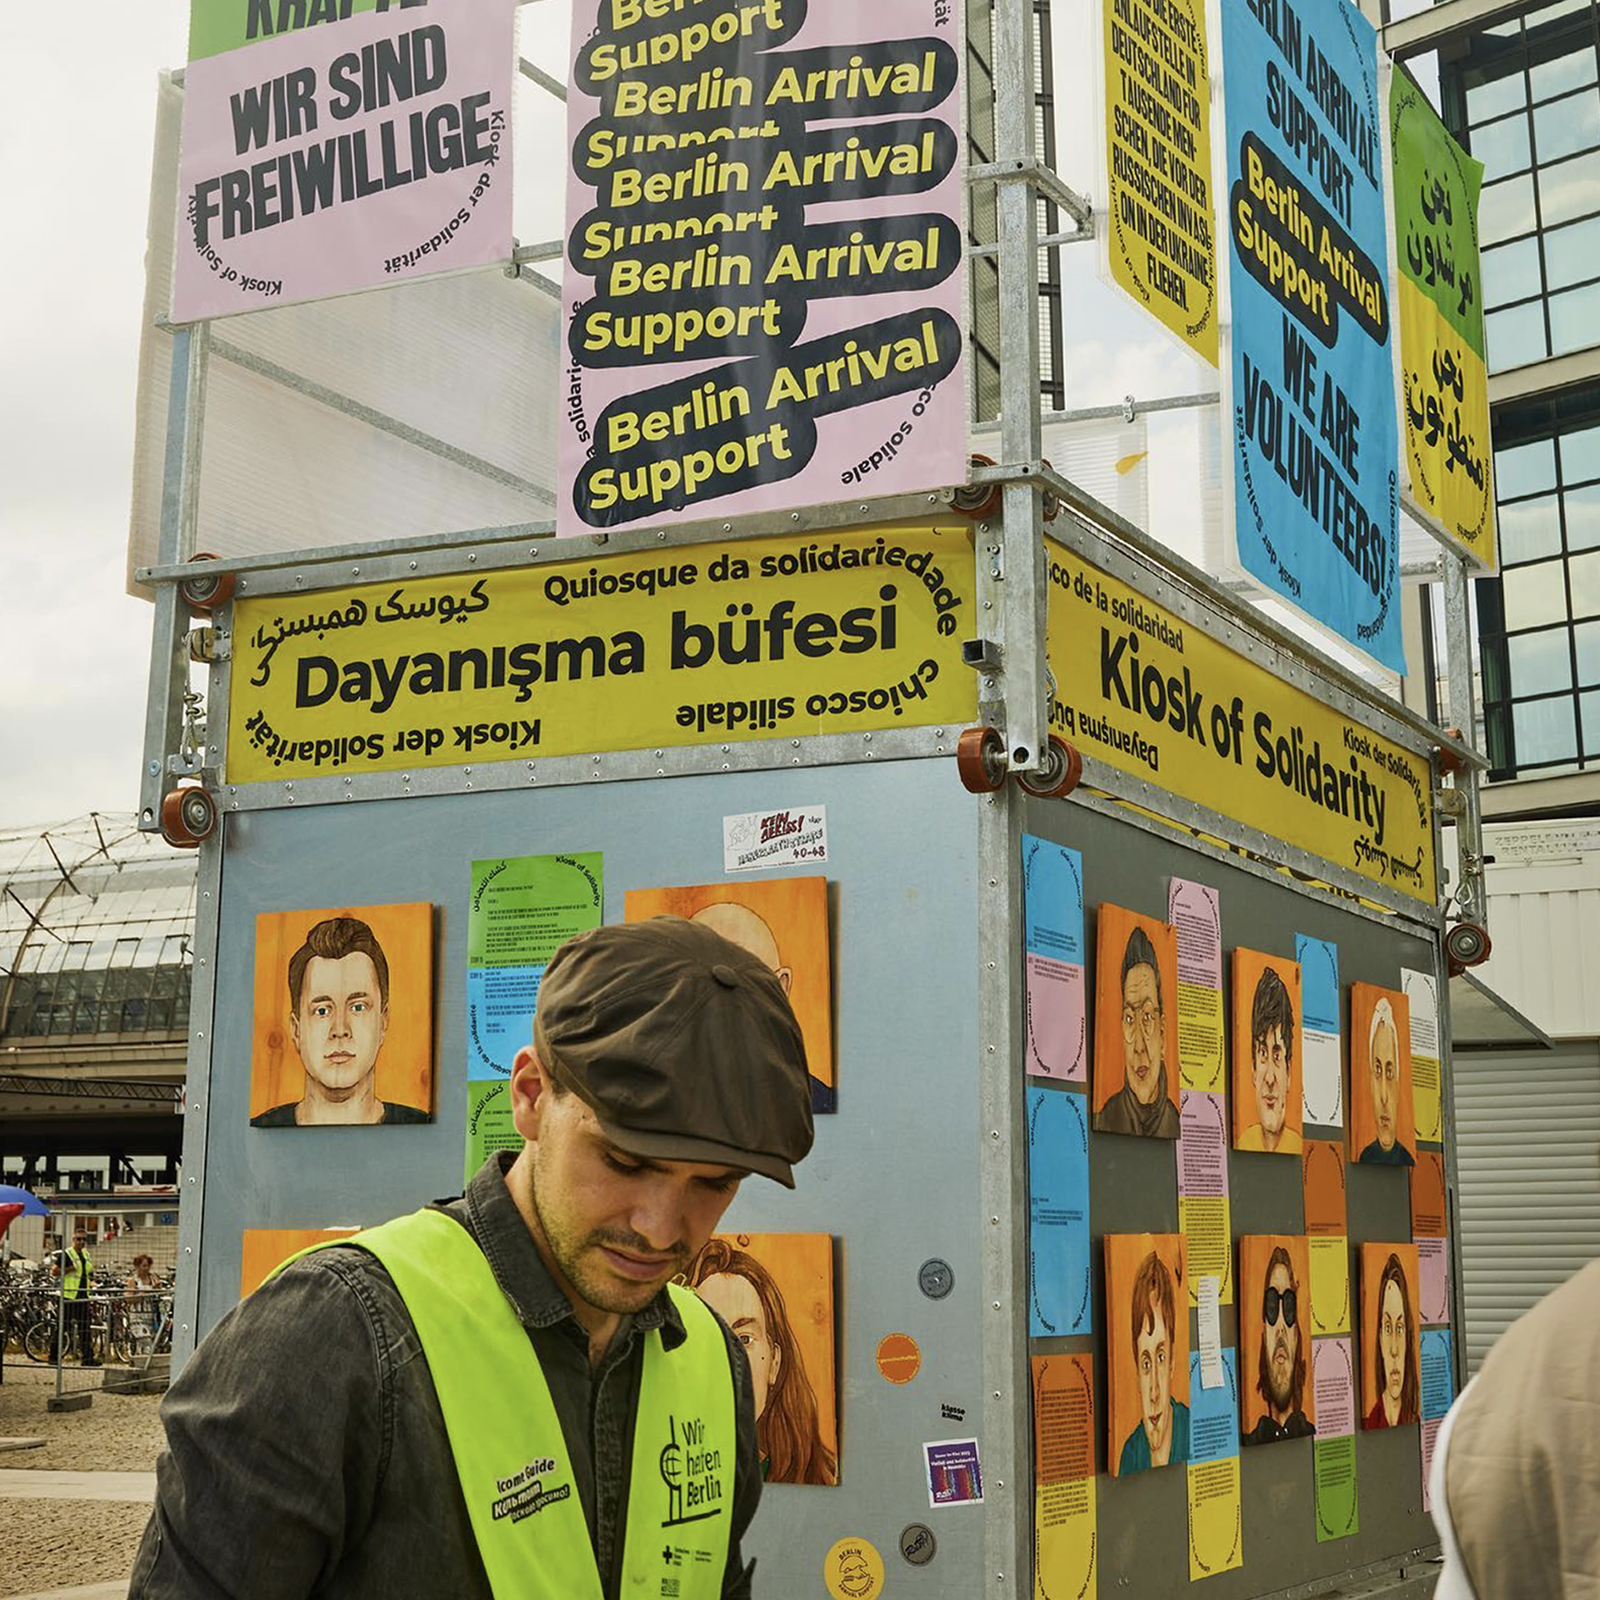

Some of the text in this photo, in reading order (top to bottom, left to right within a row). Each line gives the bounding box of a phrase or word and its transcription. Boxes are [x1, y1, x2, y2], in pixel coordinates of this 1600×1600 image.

[1168, 0, 1198, 55] ERSTE
[230, 24, 447, 156] WIR SIND
[613, 51, 936, 119] Berlin Arrival
[1111, 19, 1201, 132] DEUTSCHLAND FÜR
[1120, 68, 1197, 162] TAUSENDE MEN-
[1306, 34, 1378, 192] ARRIVAL
[194, 91, 491, 248] FREIWILLIGE
[610, 131, 935, 208] Berlin Arrival
[1112, 142, 1176, 224] RUSSISCHEN
[1114, 104, 1208, 211] SCHEN, DIE VOR DER
[1266, 60, 1354, 232] SUPPORT
[384, 110, 504, 274] Kiosk der Solidarität
[1420, 167, 1453, 227] نحن
[219, 266, 238, 282] of
[609, 226, 940, 297] Berlin Arrival
[1120, 190, 1210, 289] ON IN DER UKRAINE
[1238, 198, 1330, 327] Support
[1248, 145, 1382, 327] Berlin Arrival
[238, 275, 282, 296] Kiosk
[1147, 251, 1190, 313] FLIEHEN.
[582, 299, 781, 355] Support
[606, 380, 751, 454] Berlin
[764, 320, 940, 410] Arrival
[1282, 311, 1361, 485] WE ARE
[1432, 337, 1464, 403] نحن
[587, 422, 793, 510] Support
[840, 421, 913, 485] solidale
[1242, 351, 1387, 607] VOLUNTEERS!
[1236, 405, 1302, 599] Kiosk der Solidarität
[1388, 469, 1398, 554] Quiosco
[544, 537, 962, 636] Quiosque da solidariedade
[1073, 572, 1093, 604] de
[1096, 582, 1108, 613] la
[1111, 598, 1184, 654] solidaridad
[295, 584, 897, 714] Dayanışma büfesi
[676, 659, 939, 733] chiosco silidale
[1100, 626, 1385, 846] Kiosk of Solidarity
[245, 710, 541, 767] Kiosk der Solidarität
[1078, 711, 1159, 772] Dayanışma
[1343, 726, 1372, 759] Kiosk
[1373, 743, 1386, 769] der
[760, 811, 789, 830] KEIN
[792, 845, 826, 859] 40-48
[556, 855, 601, 907] Kiosk of Solidarity
[681, 1418, 705, 1446] Wir
[687, 1474, 722, 1507] Berlin
[838, 1548, 863, 1561] BERLIN
